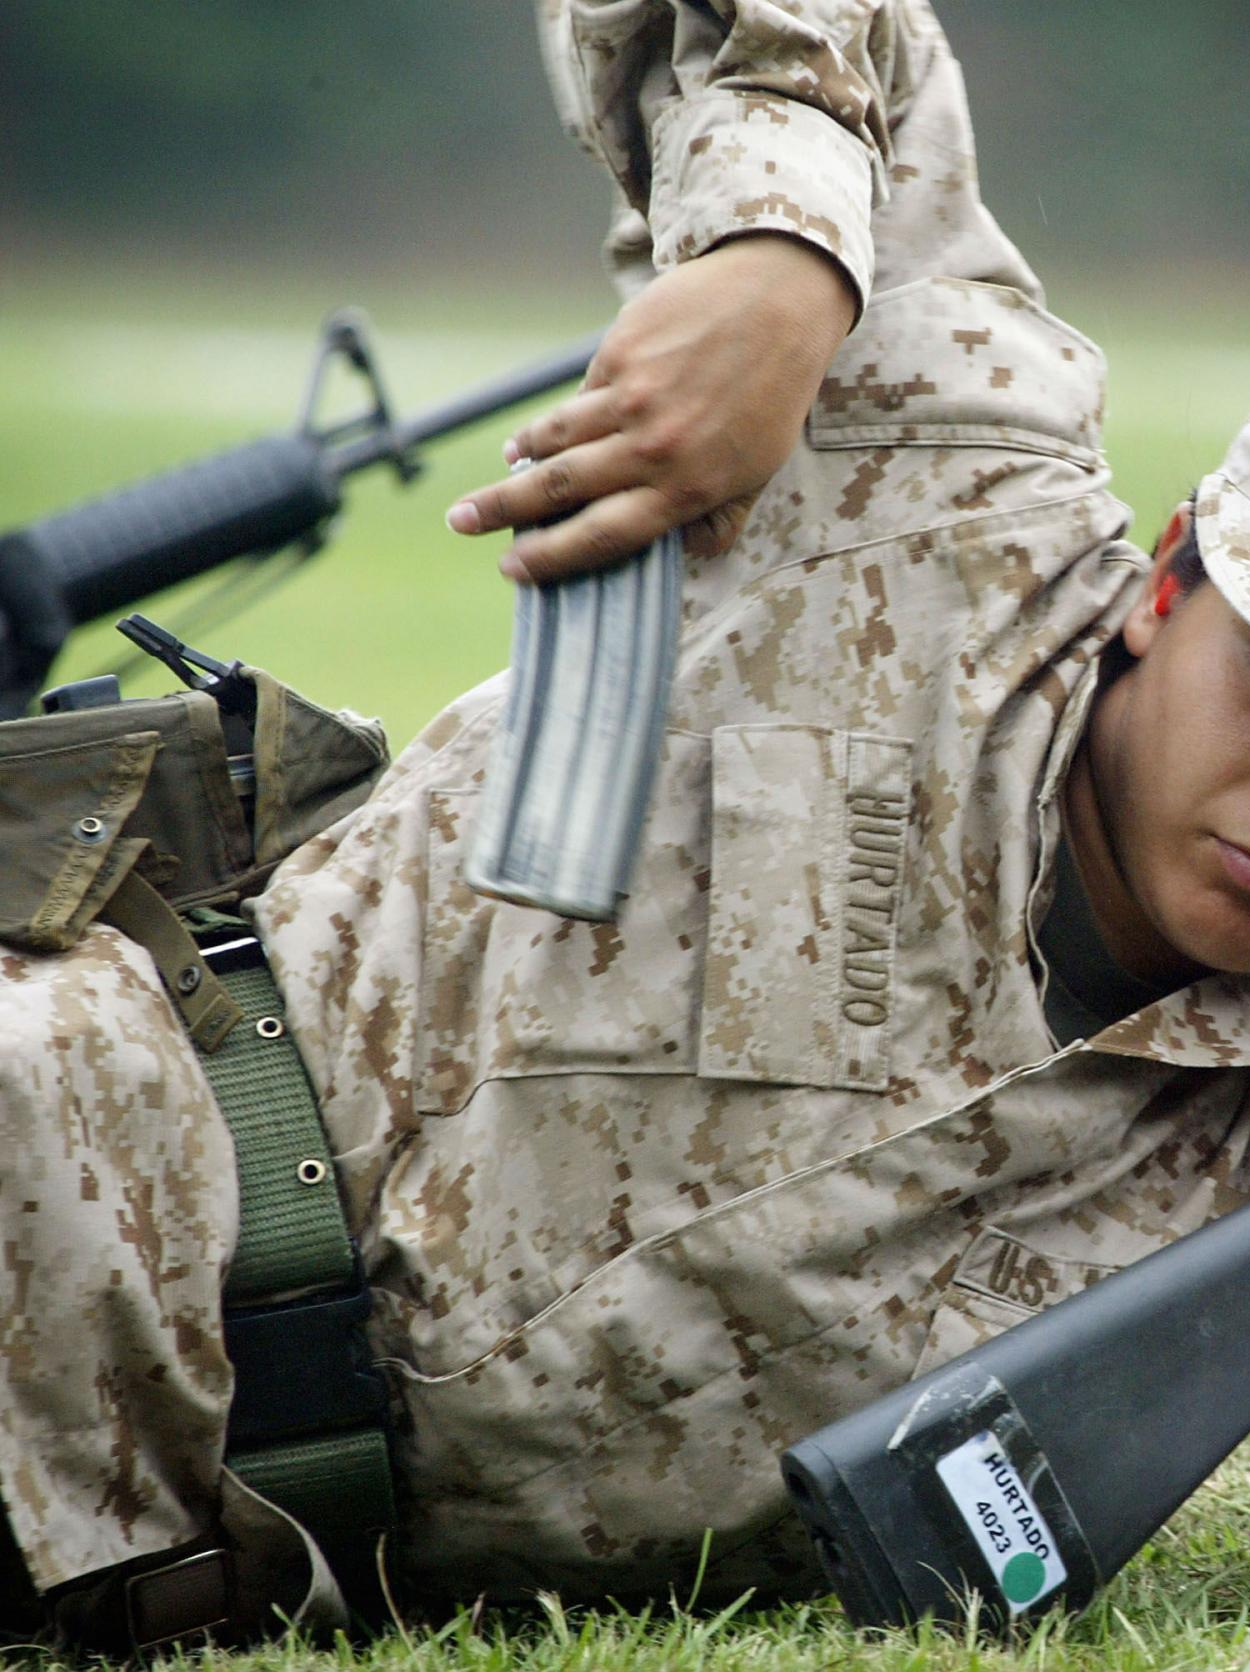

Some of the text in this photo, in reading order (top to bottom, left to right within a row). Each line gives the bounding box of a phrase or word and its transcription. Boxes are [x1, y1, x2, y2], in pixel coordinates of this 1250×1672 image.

[846, 790, 904, 1026] HURTADO
[977, 1501, 1012, 1553] 4023
[984, 1453, 1049, 1560] HURTADO
